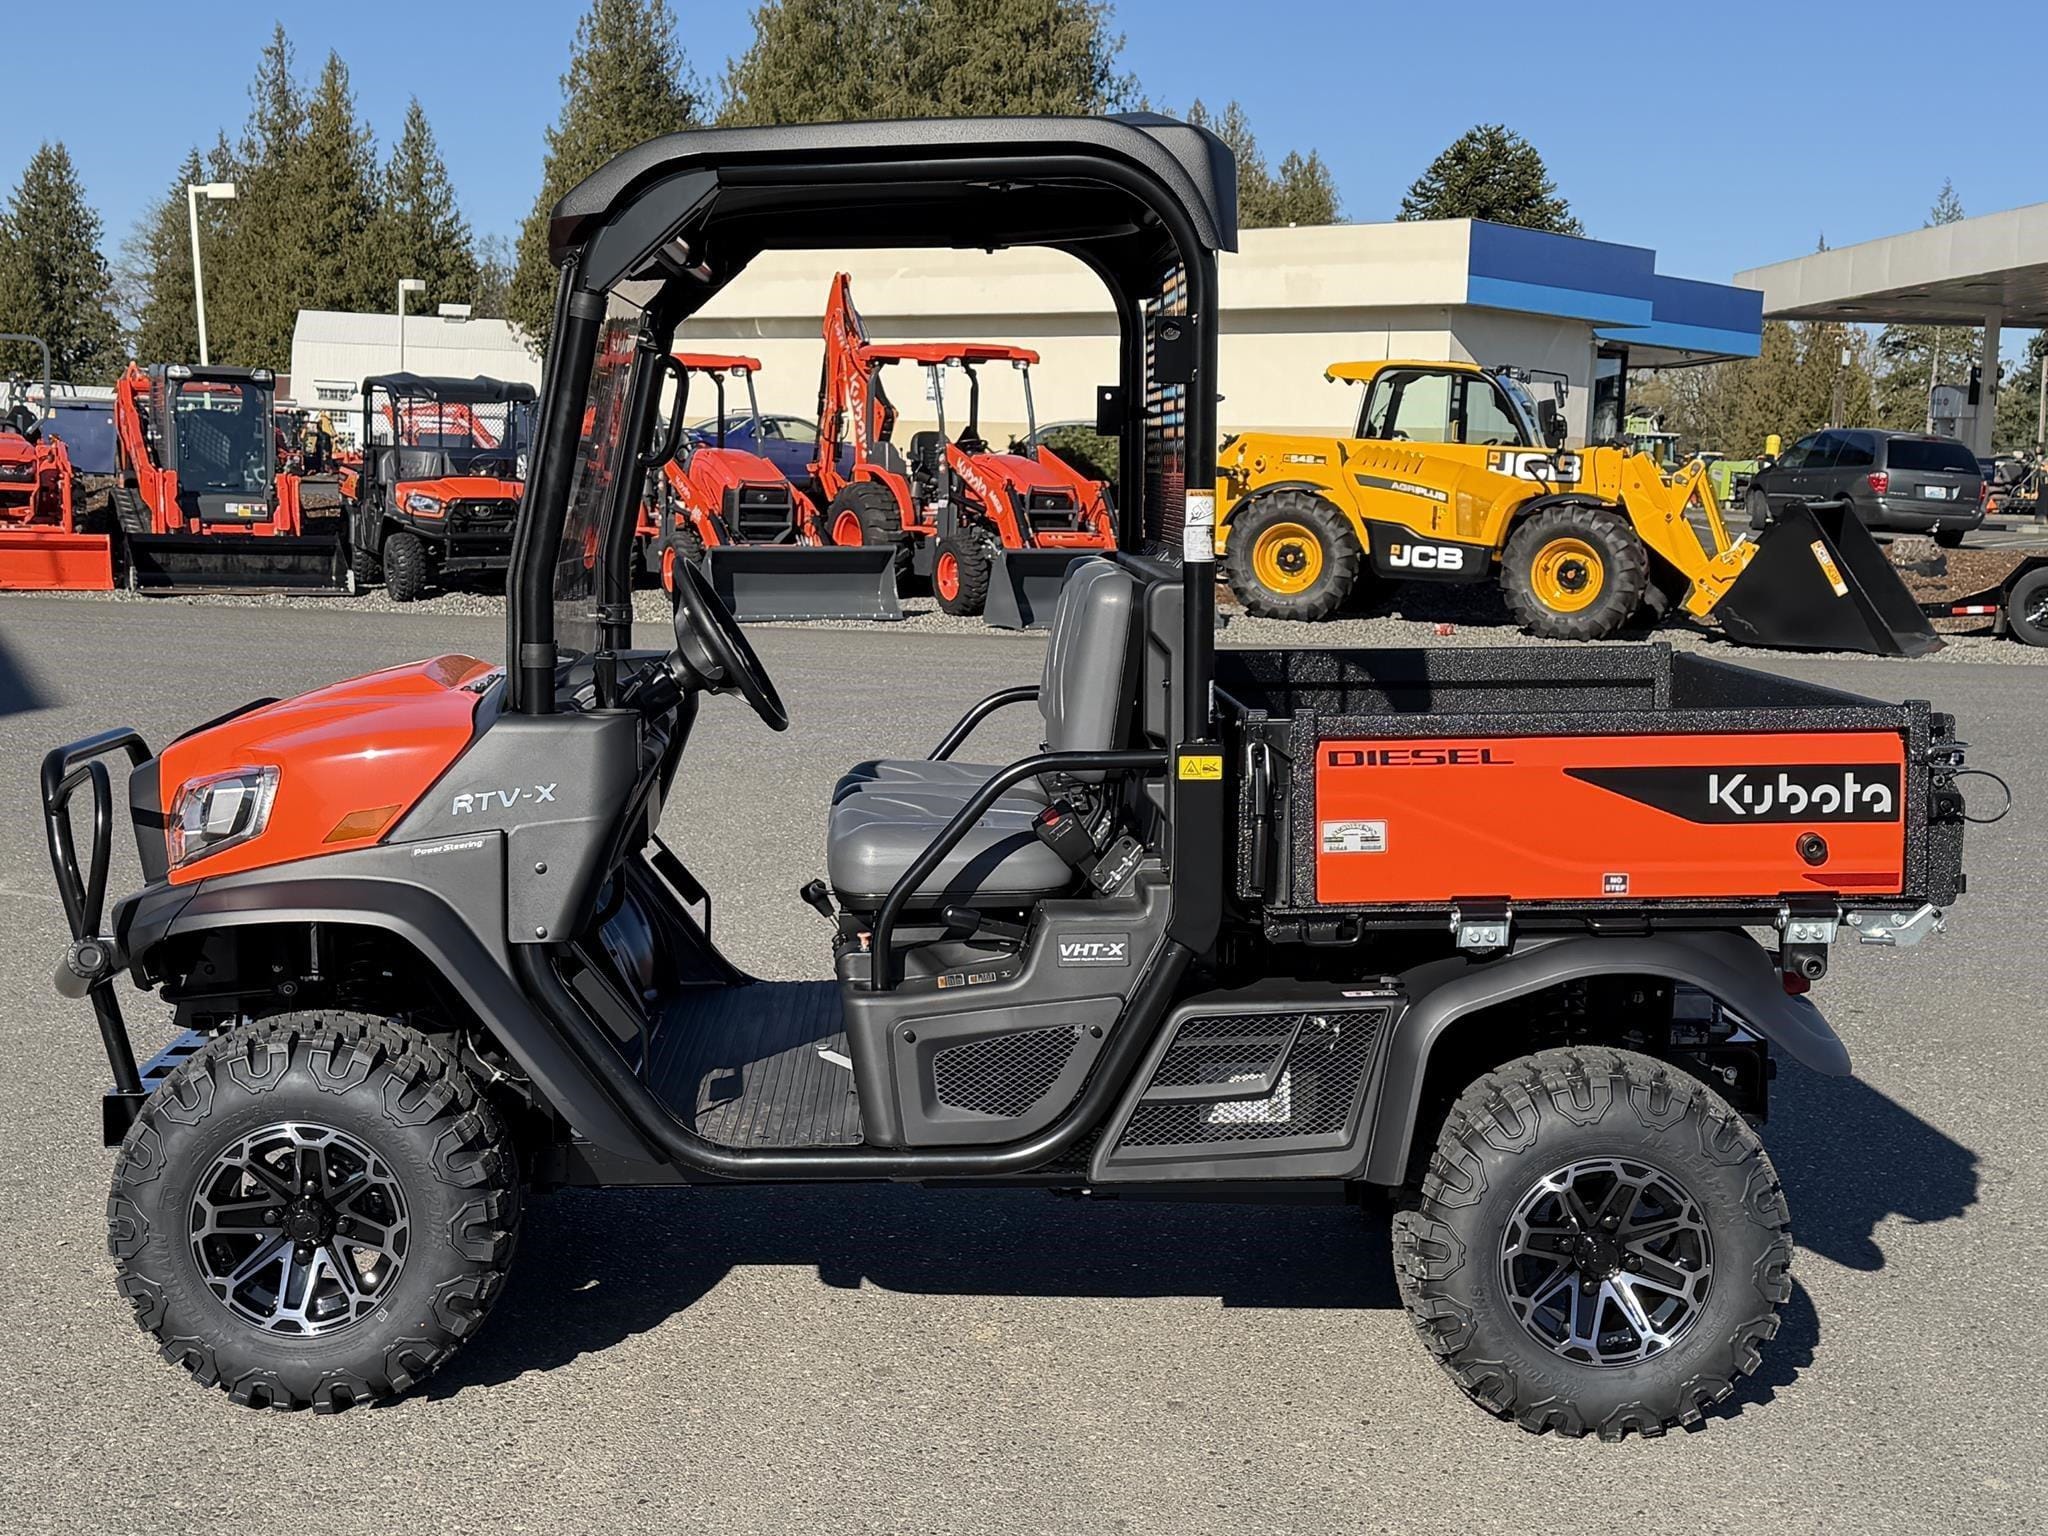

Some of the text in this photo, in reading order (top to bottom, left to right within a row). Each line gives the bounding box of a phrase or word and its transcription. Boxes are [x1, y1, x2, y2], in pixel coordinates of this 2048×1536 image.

[1488, 452, 1581, 482] JCB
[1389, 544, 1463, 570] JCB
[1328, 748, 1515, 767] DIESEL
[452, 783, 558, 816] RTV-X
[1708, 772, 1893, 815] Kubota
[413, 839, 484, 857] Power Steering
[1060, 943, 1126, 956] VHT-X
